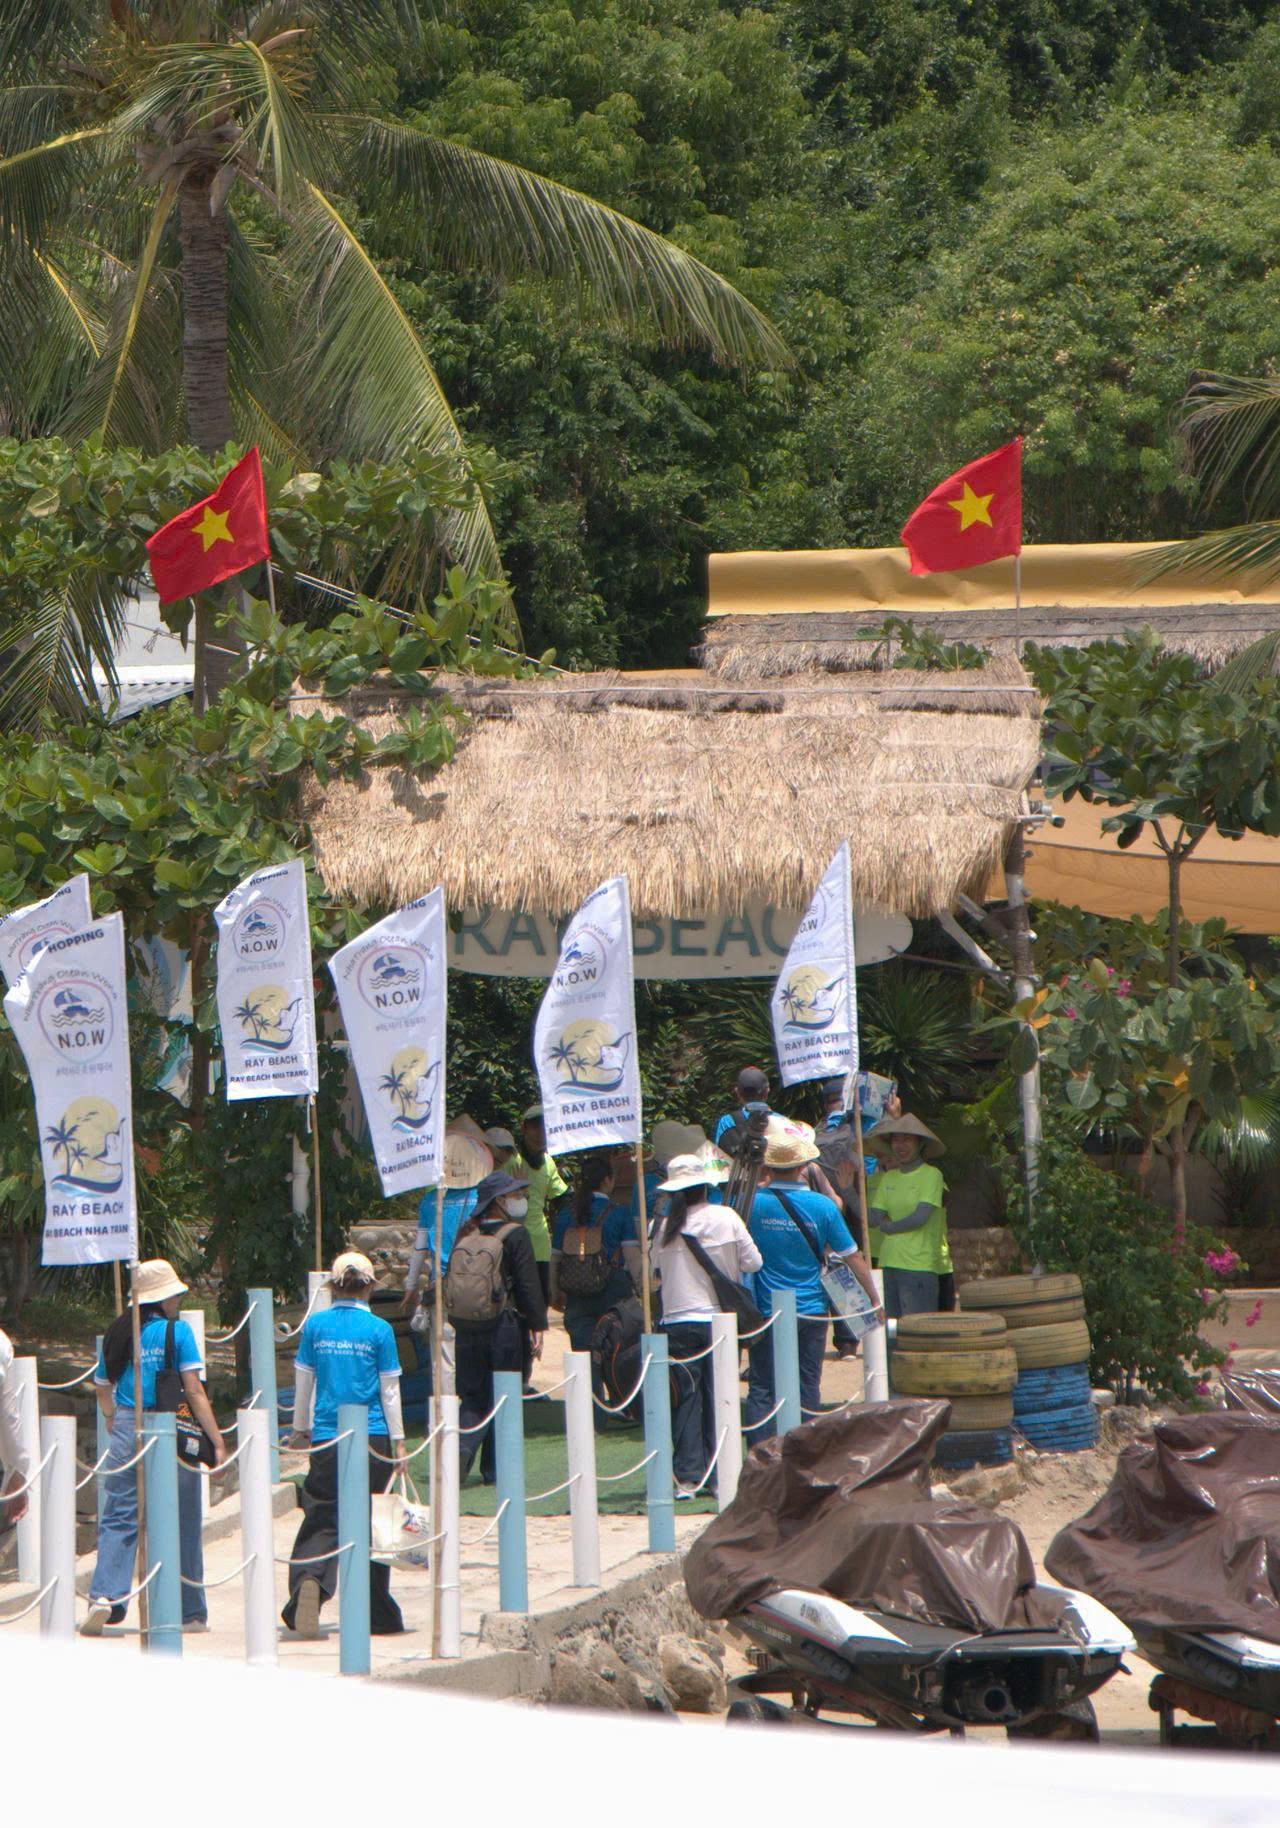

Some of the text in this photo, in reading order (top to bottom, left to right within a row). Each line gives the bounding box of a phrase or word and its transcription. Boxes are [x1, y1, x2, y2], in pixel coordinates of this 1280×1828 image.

[632, 903, 794, 957] BEAC
[47, 928, 105, 954] HOPPING
[240, 939, 279, 954] N.O.W
[556, 968, 597, 988] N.O.W
[375, 988, 420, 1009] N.O.W
[58, 1029, 105, 1049] N.O.W
[785, 1034, 839, 1051] RAY BEACH
[245, 1055, 298, 1068] RAY BEACH
[230, 1075, 245, 1083] RAY
[246, 1074, 270, 1082] BEACH
[286, 1069, 308, 1078] TRANG
[562, 1097, 630, 1115] RAY BEACH
[566, 1120, 595, 1131] BEACH
[597, 1117, 615, 1126] NHA
[52, 1202, 124, 1216] RAY BEACH
[54, 1227, 83, 1238] BEACH
[85, 1226, 109, 1236] NHA
[111, 1224, 128, 1234] TRAN
